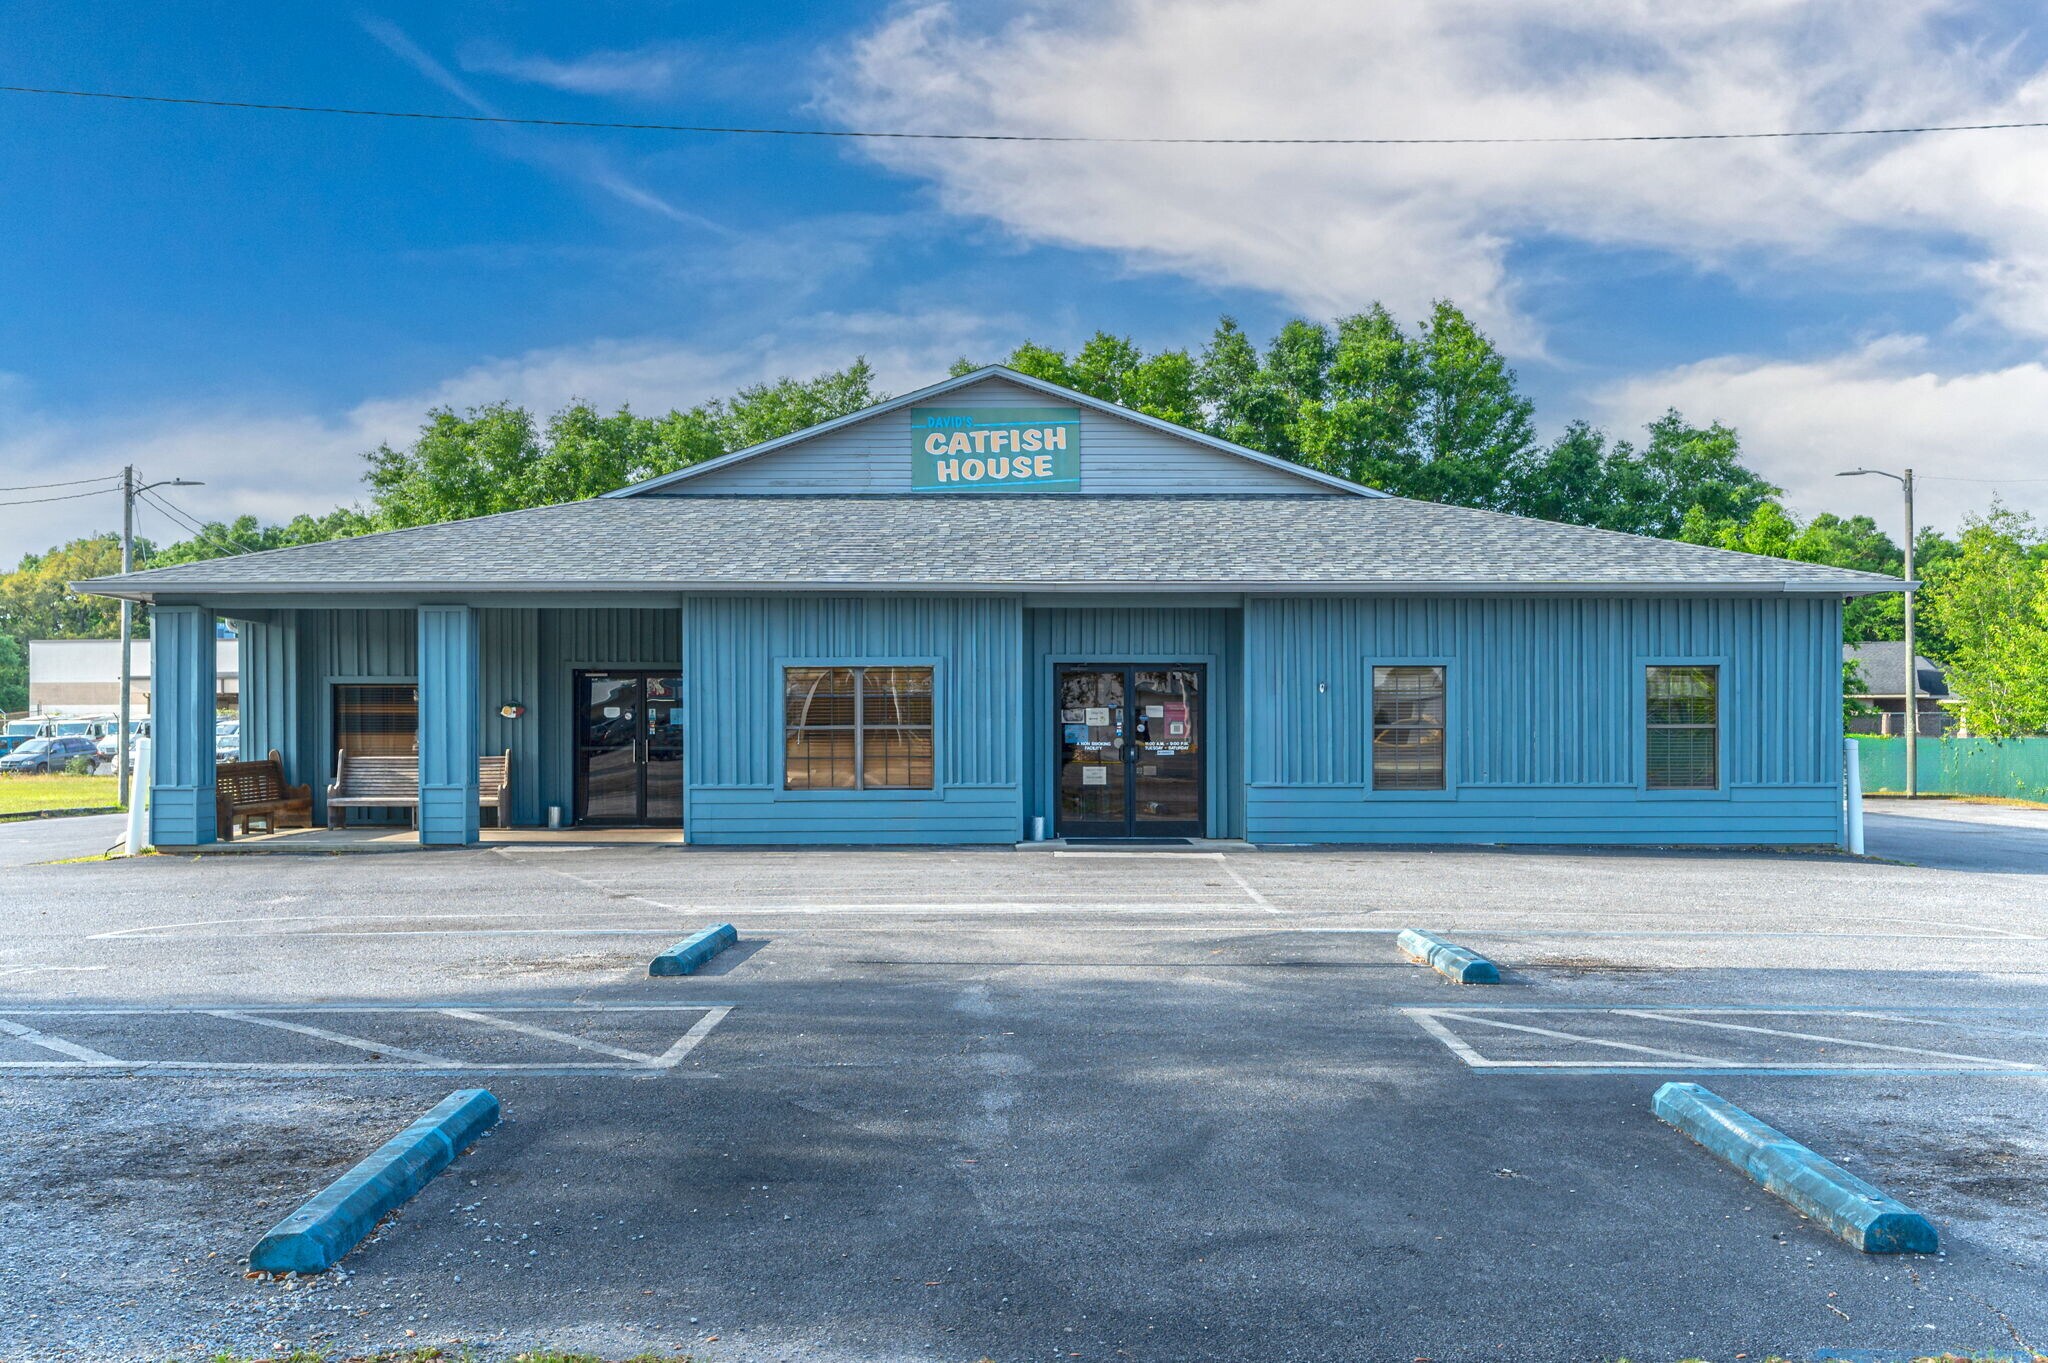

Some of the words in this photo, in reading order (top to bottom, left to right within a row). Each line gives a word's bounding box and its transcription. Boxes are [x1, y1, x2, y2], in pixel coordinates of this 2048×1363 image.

[927, 415, 974, 428] DAVID'S
[924, 427, 1067, 455] CATFISH
[936, 455, 1054, 482] HOUSE
